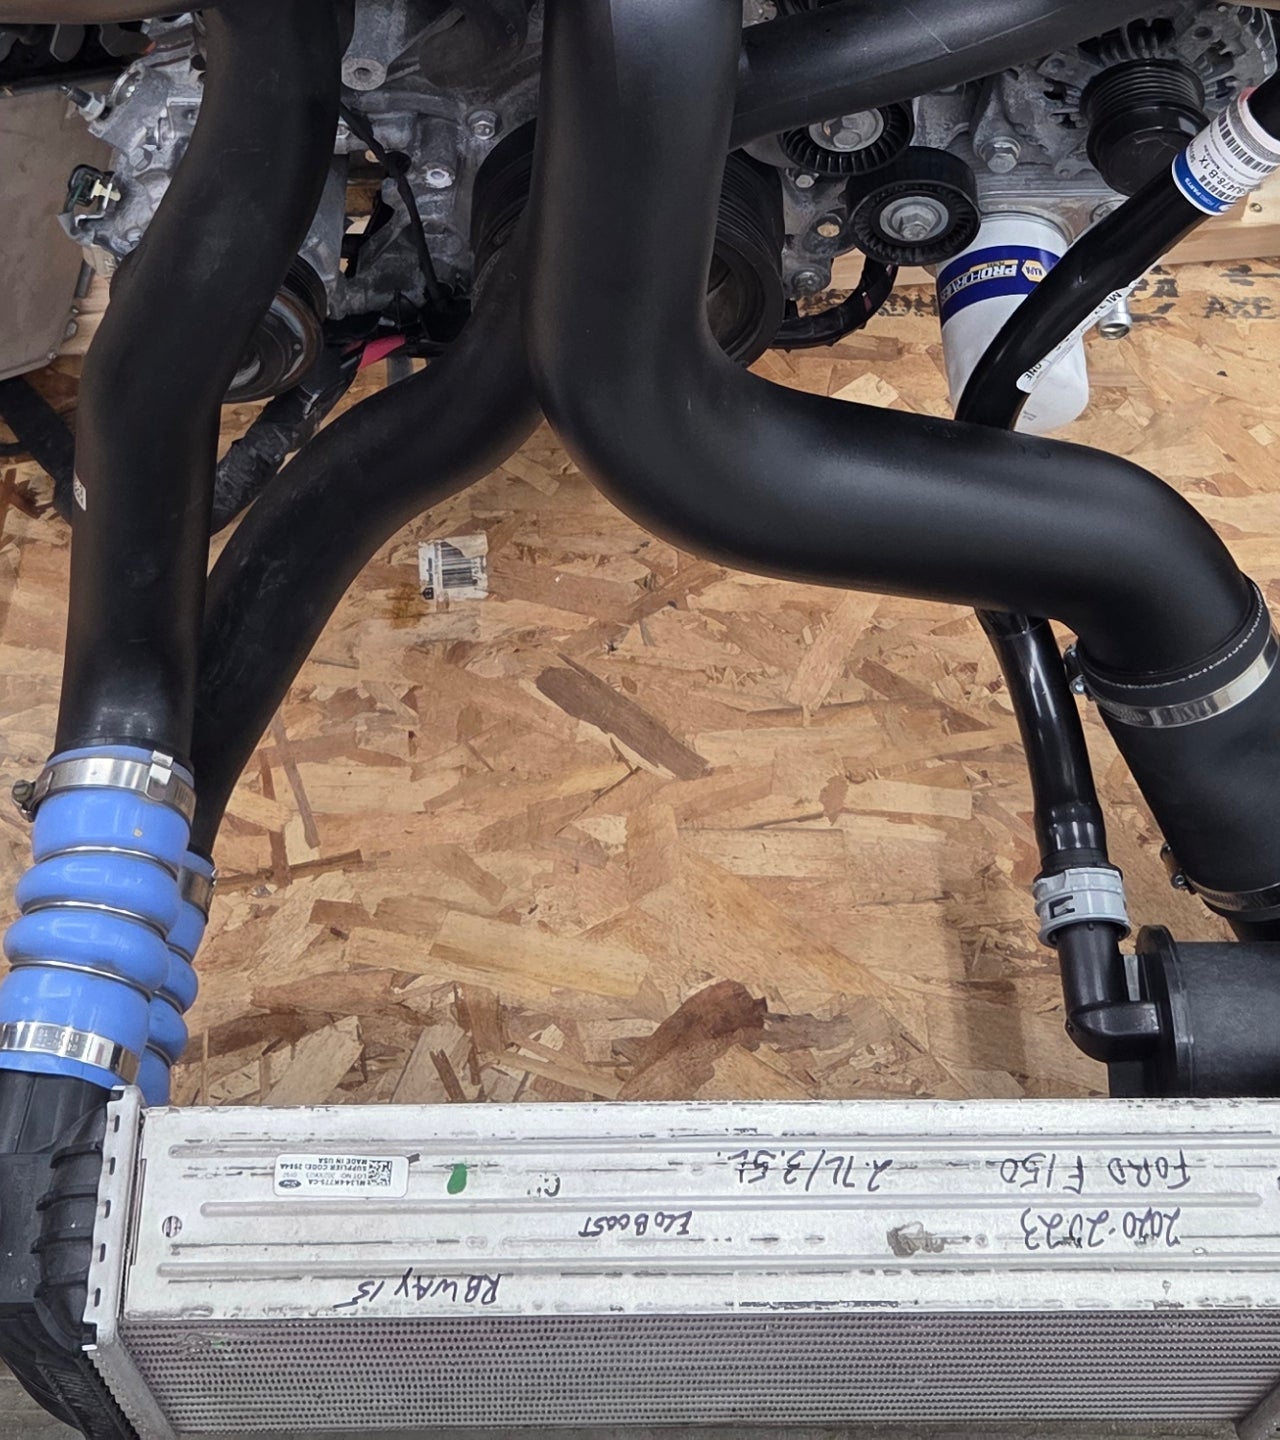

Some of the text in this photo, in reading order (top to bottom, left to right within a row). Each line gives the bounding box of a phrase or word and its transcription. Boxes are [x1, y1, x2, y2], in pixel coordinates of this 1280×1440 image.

[1198, 156, 1211, 170] 1X
[1184, 177, 1202, 197] PARTS
[1025, 266, 1044, 277] NAPA
[330, 1164, 367, 1172] SUPPLIER
[1108, 1148, 1192, 1190] FORD
